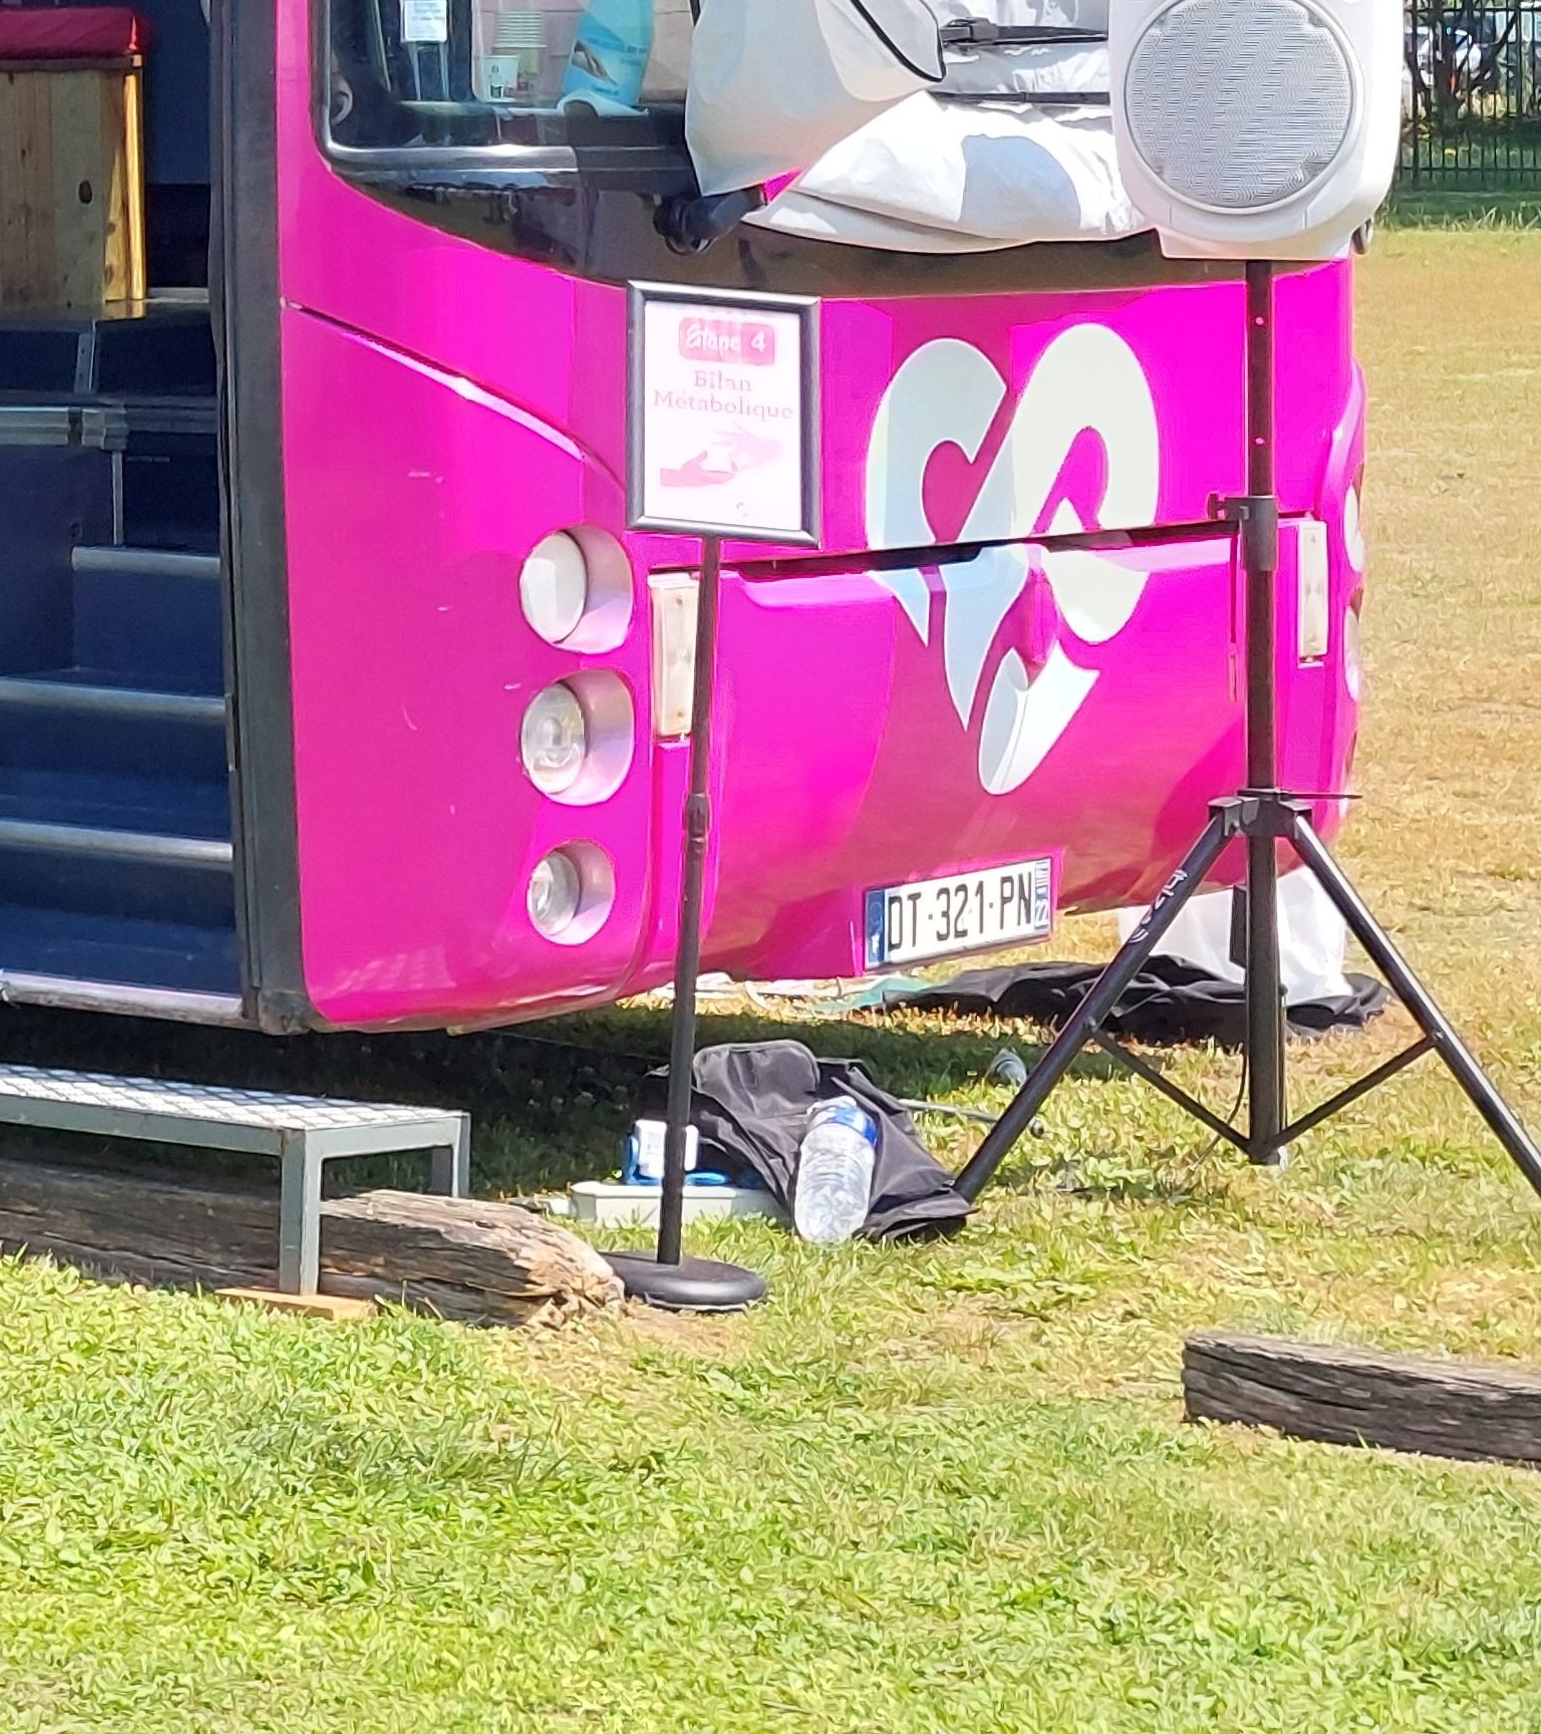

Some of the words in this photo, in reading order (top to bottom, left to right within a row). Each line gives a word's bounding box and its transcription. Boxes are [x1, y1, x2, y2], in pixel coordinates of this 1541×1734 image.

[750, 330, 767, 353] 4
[693, 369, 753, 393] Bilan
[652, 389, 794, 421] Métabolique
